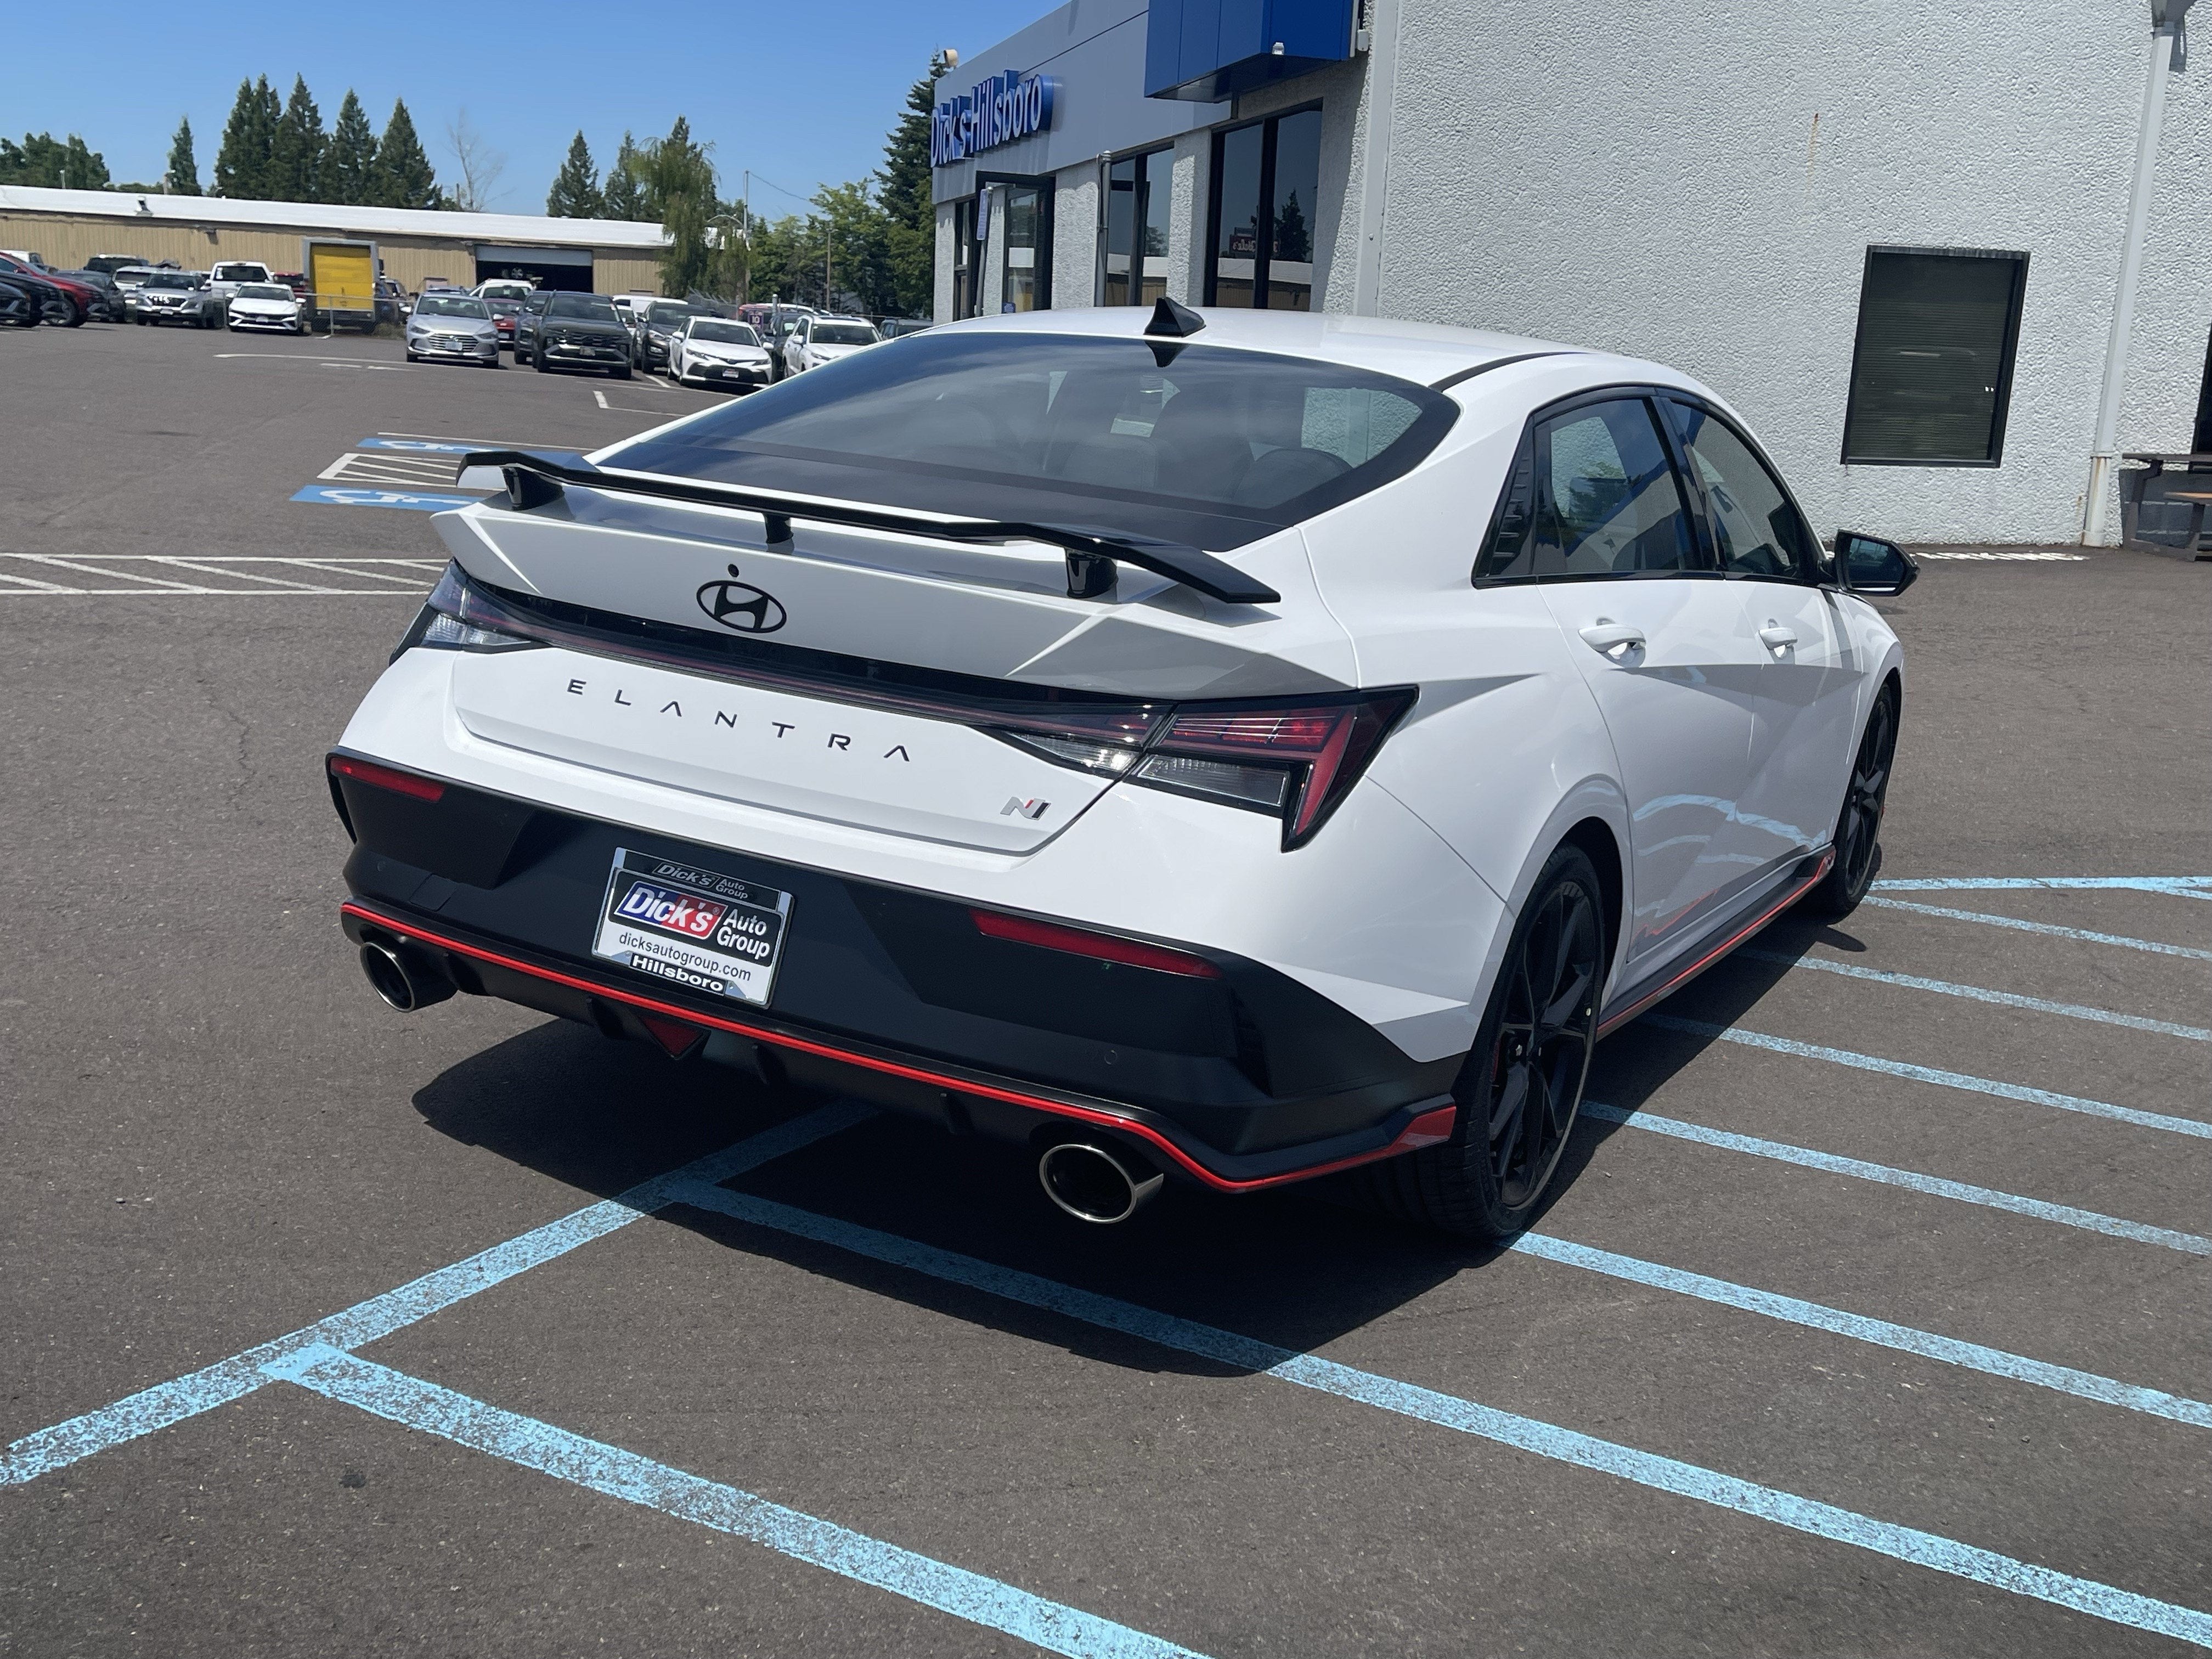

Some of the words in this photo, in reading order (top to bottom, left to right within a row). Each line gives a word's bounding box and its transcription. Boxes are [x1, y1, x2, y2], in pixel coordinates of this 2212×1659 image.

[930, 95, 967, 168] Dick's
[970, 70, 1044, 153] Hillsboro
[567, 678, 910, 762] ELANTRA
[657, 865, 712, 886] Dick's
[715, 884, 748, 900] Group
[719, 878, 745, 891] Auto
[623, 887, 713, 933] Dick's
[723, 909, 767, 936] Auto
[619, 932, 751, 981] dicksautogroup.com
[716, 926, 770, 960] Group
[631, 955, 724, 992] Hillsboro
